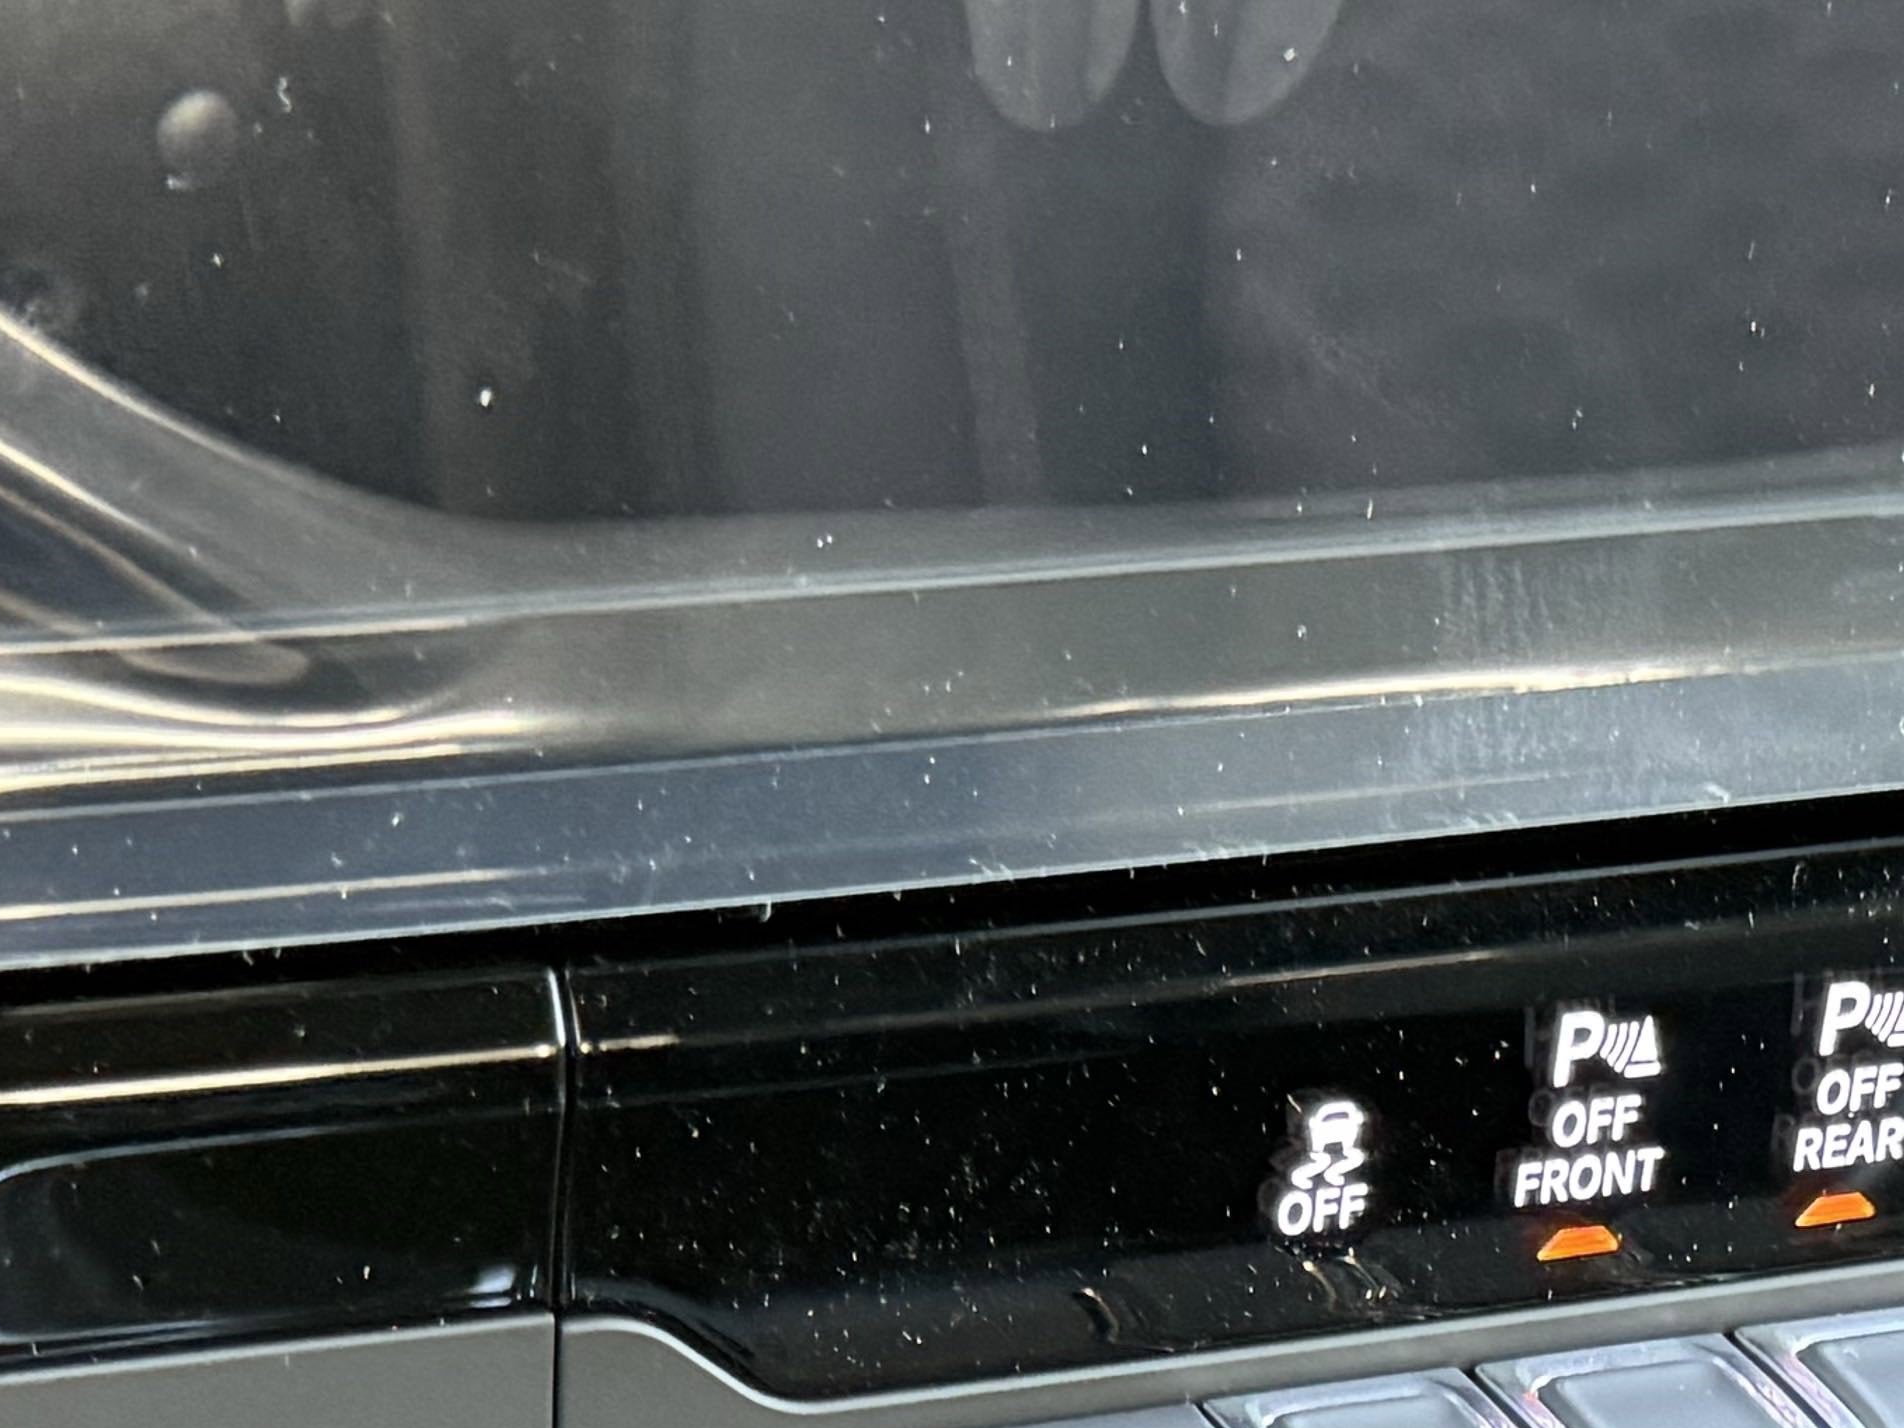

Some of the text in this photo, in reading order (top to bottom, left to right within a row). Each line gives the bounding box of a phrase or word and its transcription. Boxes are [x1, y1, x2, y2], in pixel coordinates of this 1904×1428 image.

[1551, 1093, 1643, 1149] OFF
[1513, 1145, 1666, 1208] FRONT
[1276, 1182, 1370, 1237] OFF
